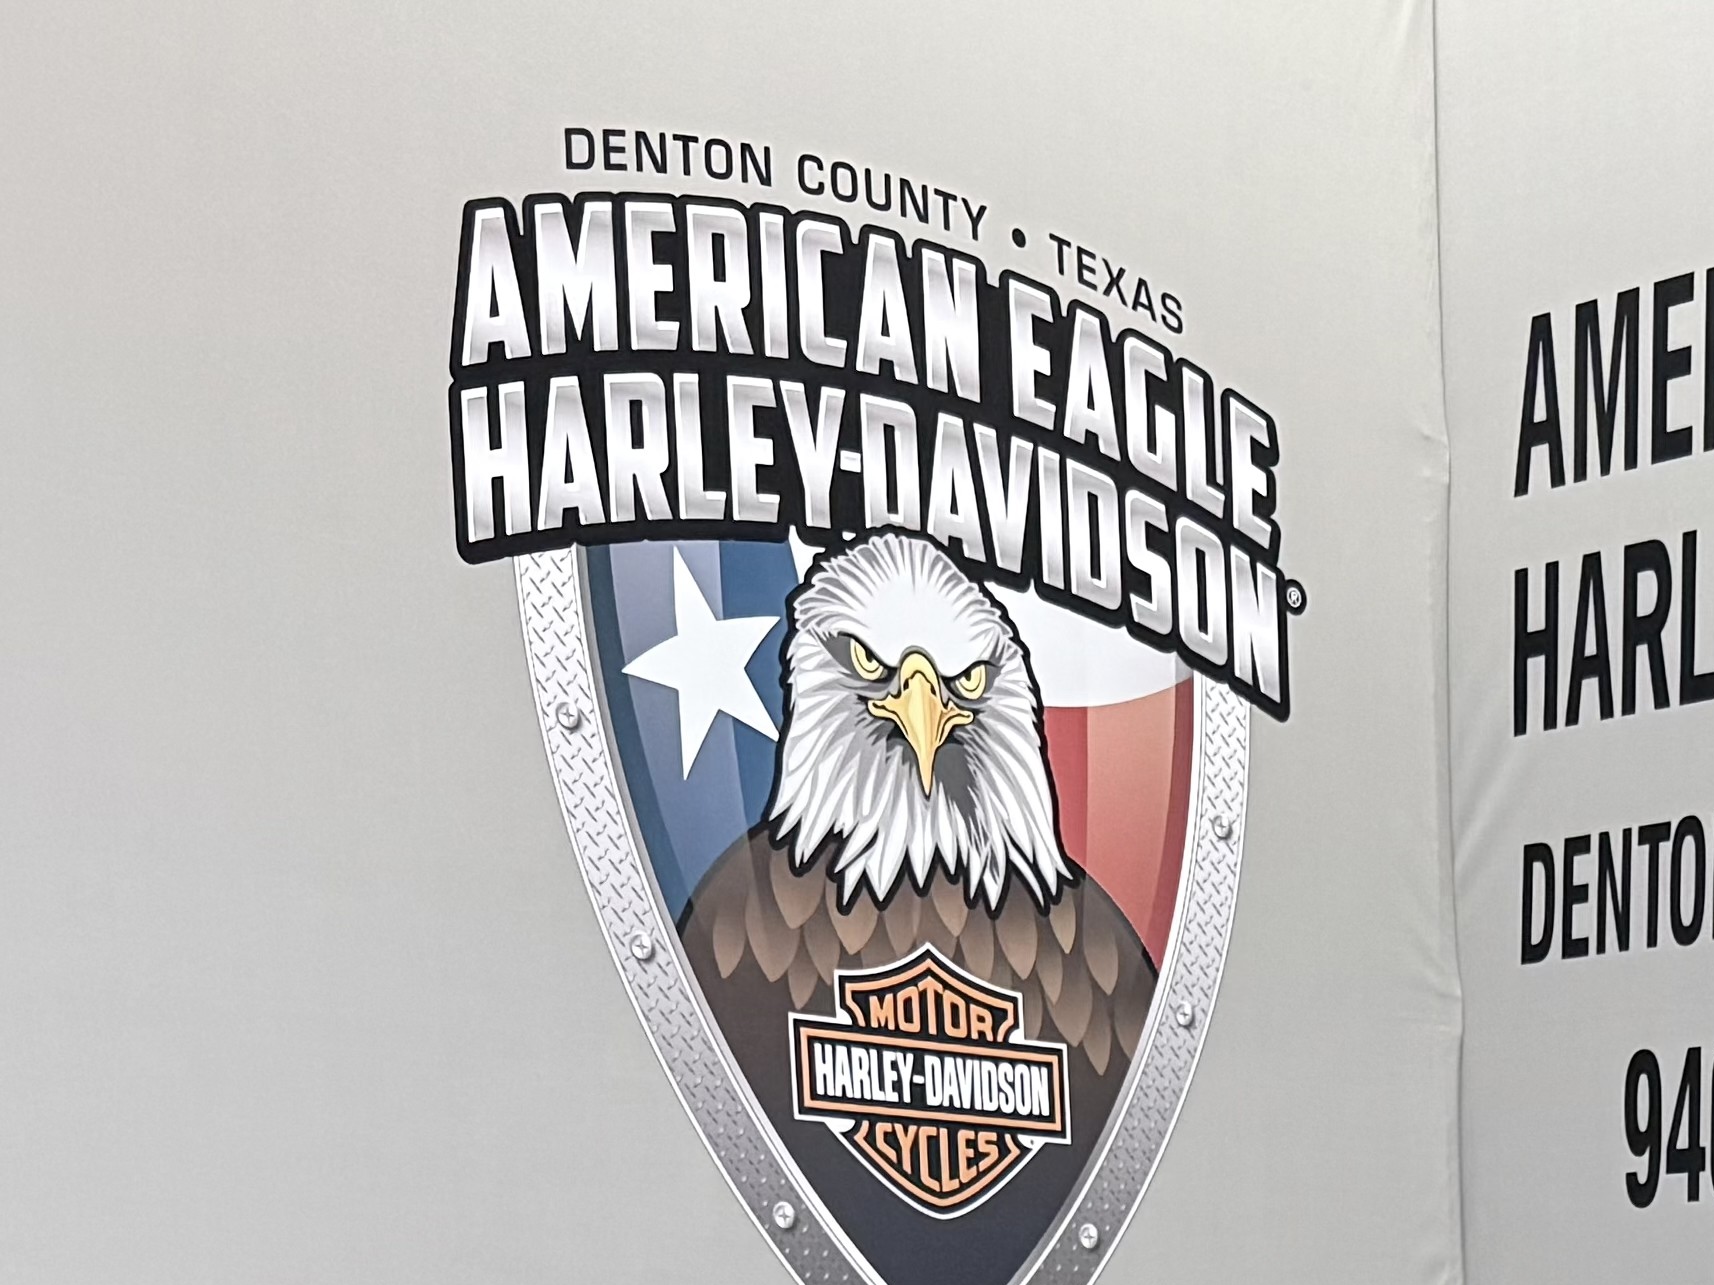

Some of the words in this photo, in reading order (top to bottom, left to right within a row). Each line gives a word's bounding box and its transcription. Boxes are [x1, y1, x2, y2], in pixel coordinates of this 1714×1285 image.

[563, 127, 773, 187] DENTON
[797, 153, 988, 242] COUNTY
[1048, 231, 1184, 335] TEXAS
[460, 200, 982, 403] AMERICAN
[1006, 276, 1278, 544] EAGLE
[457, 370, 1287, 706] HARLEY-DAVIDSON
[813, 1042, 1051, 1118] HARLEY-DAVIDSON
[868, 975, 995, 1043] MOTOR
[875, 1120, 999, 1193] CYCLES
